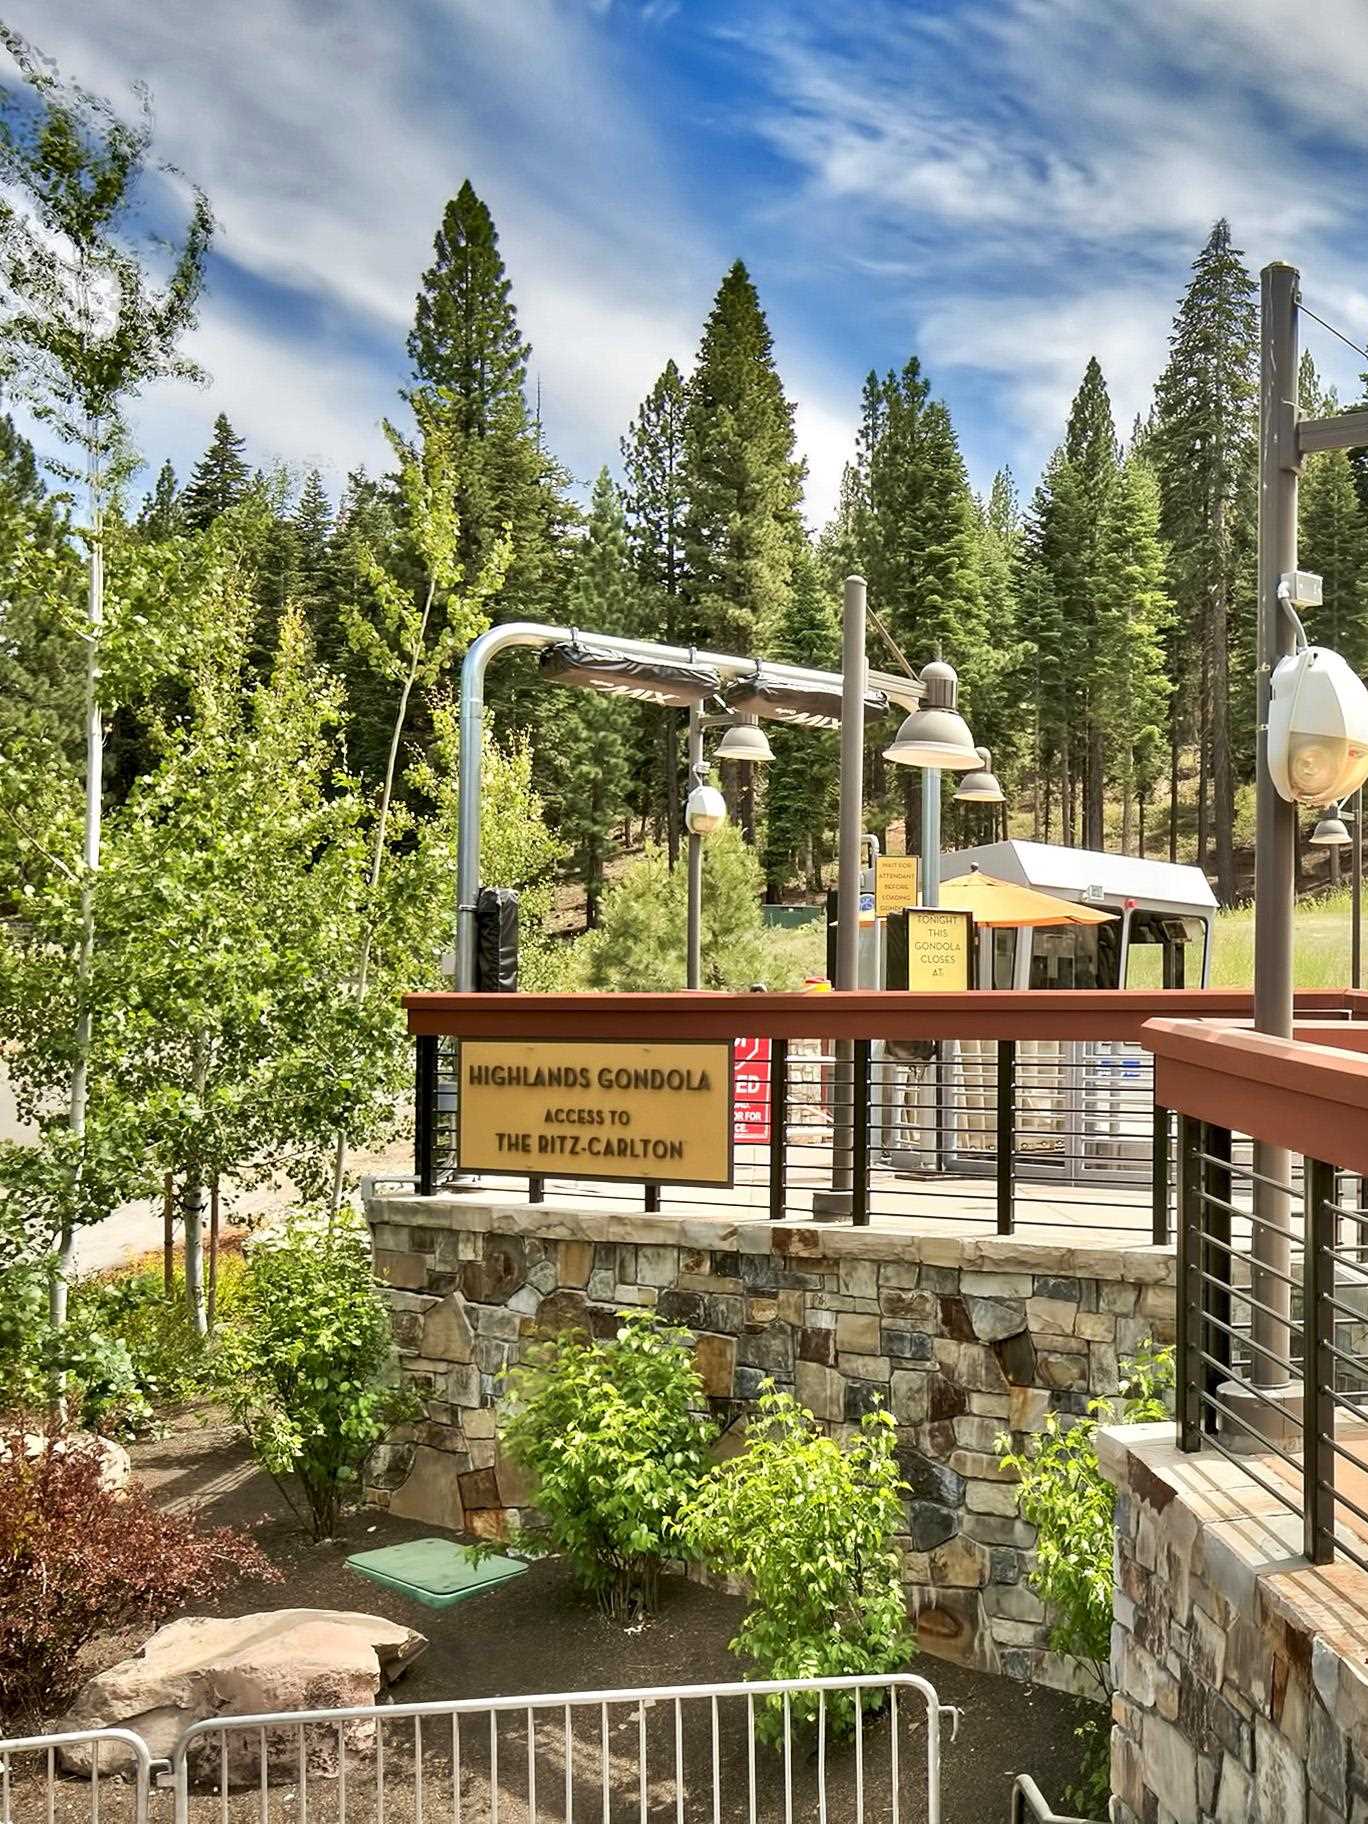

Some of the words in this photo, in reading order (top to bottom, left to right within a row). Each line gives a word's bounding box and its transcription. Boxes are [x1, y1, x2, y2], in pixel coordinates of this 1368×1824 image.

[917, 915, 959, 925] TONIGHT
[927, 929, 949, 938] THIS
[914, 941, 962, 952] GONDOLA
[920, 955, 957, 965] CLOSES
[468, 1064, 591, 1088] HIGHLANDS
[597, 1067, 712, 1092] GONDOLA
[543, 1108, 605, 1126] ACCESS
[608, 1109, 631, 1127] TO
[495, 1132, 532, 1153] THE
[537, 1136, 685, 1160] RITZ-CARLTON
